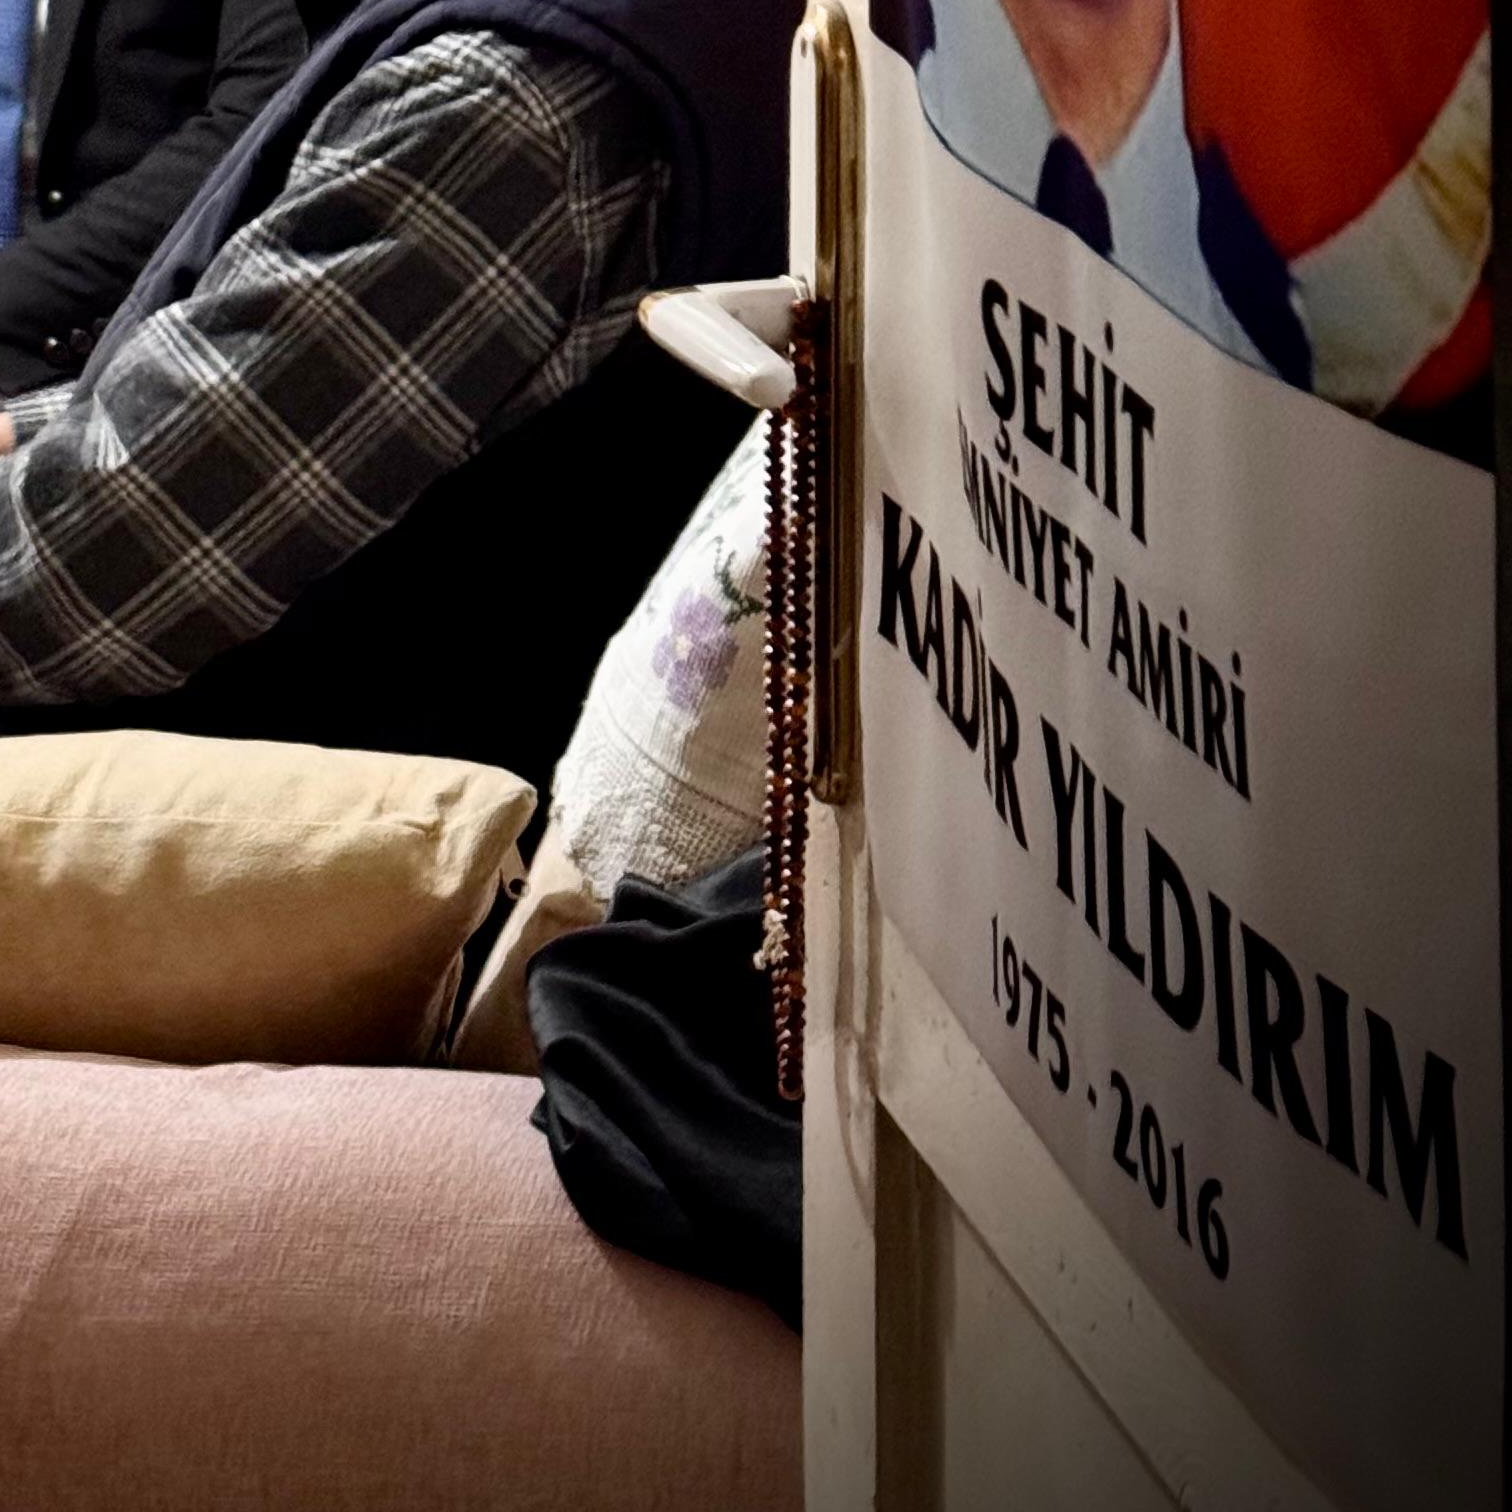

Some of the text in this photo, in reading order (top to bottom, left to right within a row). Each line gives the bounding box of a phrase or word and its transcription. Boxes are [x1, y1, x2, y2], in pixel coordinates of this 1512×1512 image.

[981, 278, 1155, 548] ŞEHİT
[1107, 574, 1251, 803] AMİRİ
[877, 491, 1470, 1265] KADİR YILDIRIM
[991, 912, 1070, 1095] 1975
[1110, 1069, 1230, 1282] 2016
